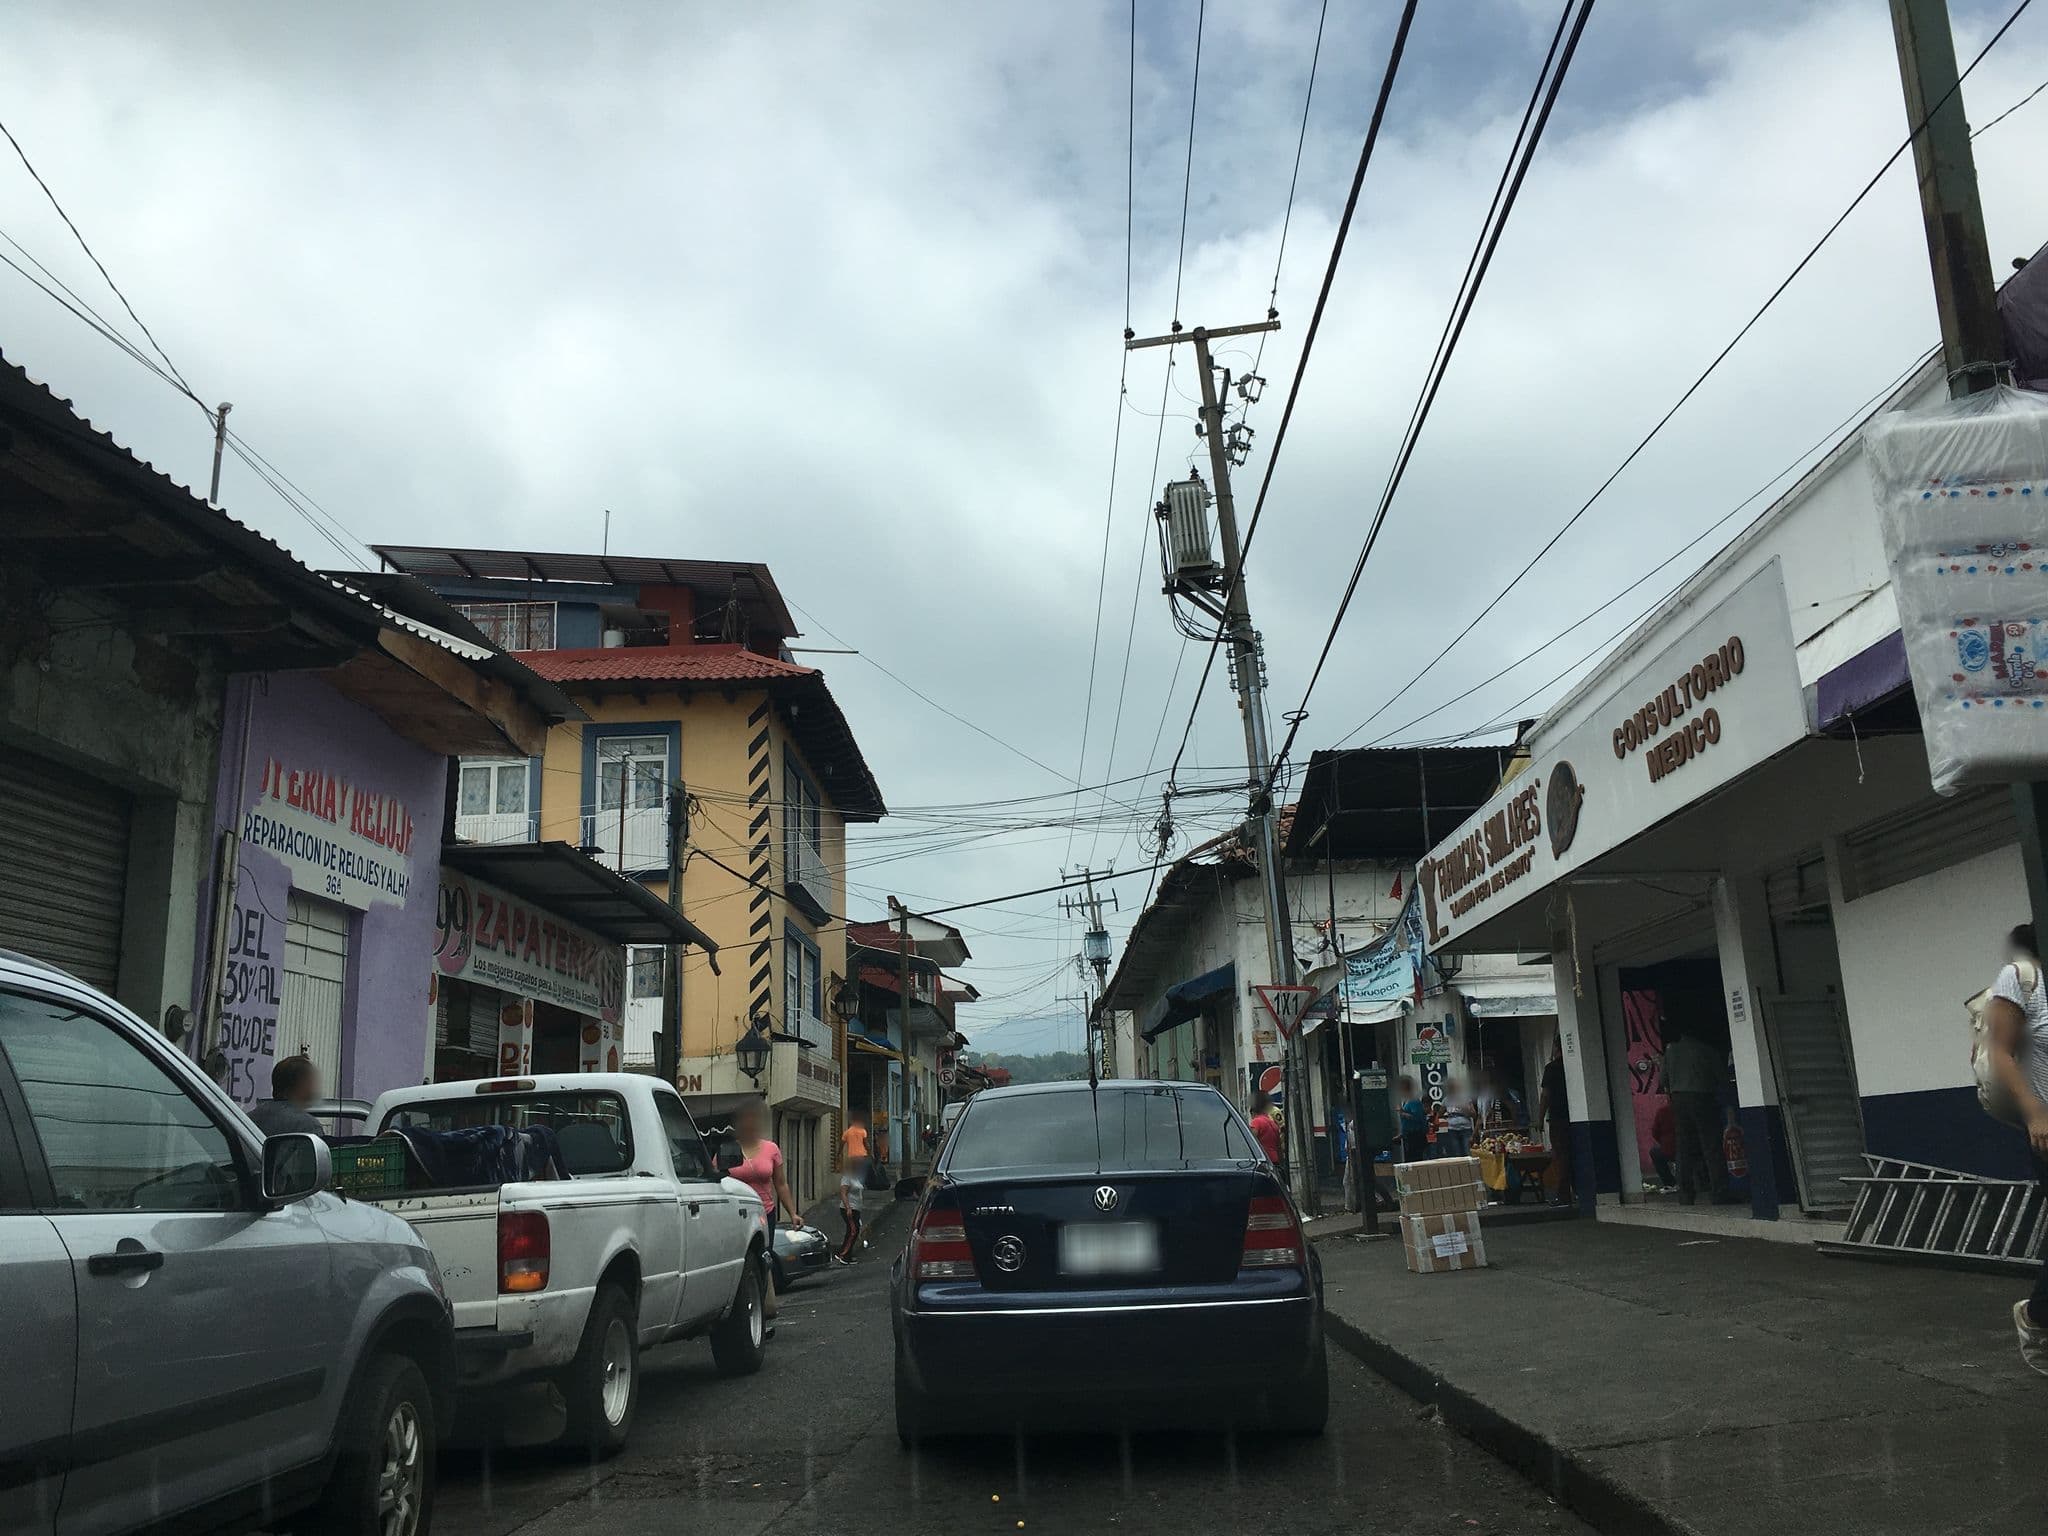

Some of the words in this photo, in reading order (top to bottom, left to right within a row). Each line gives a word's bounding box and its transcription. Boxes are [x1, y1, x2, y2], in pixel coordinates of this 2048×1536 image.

[1613, 636, 1745, 760] CONSULTORIO
[1646, 708, 1721, 783] MEDICO
[243, 813, 322, 865] REPARACION
[323, 840, 338, 870] DE
[338, 847, 379, 887] RELOJES
[379, 866, 387, 888] Y
[228, 903, 270, 961] DEL
[224, 961, 258, 1005] 30%
[257, 964, 281, 1006] AL
[474, 955, 487, 972] Los
[487, 962, 514, 984] mejores
[250, 1016, 277, 1057] DE
